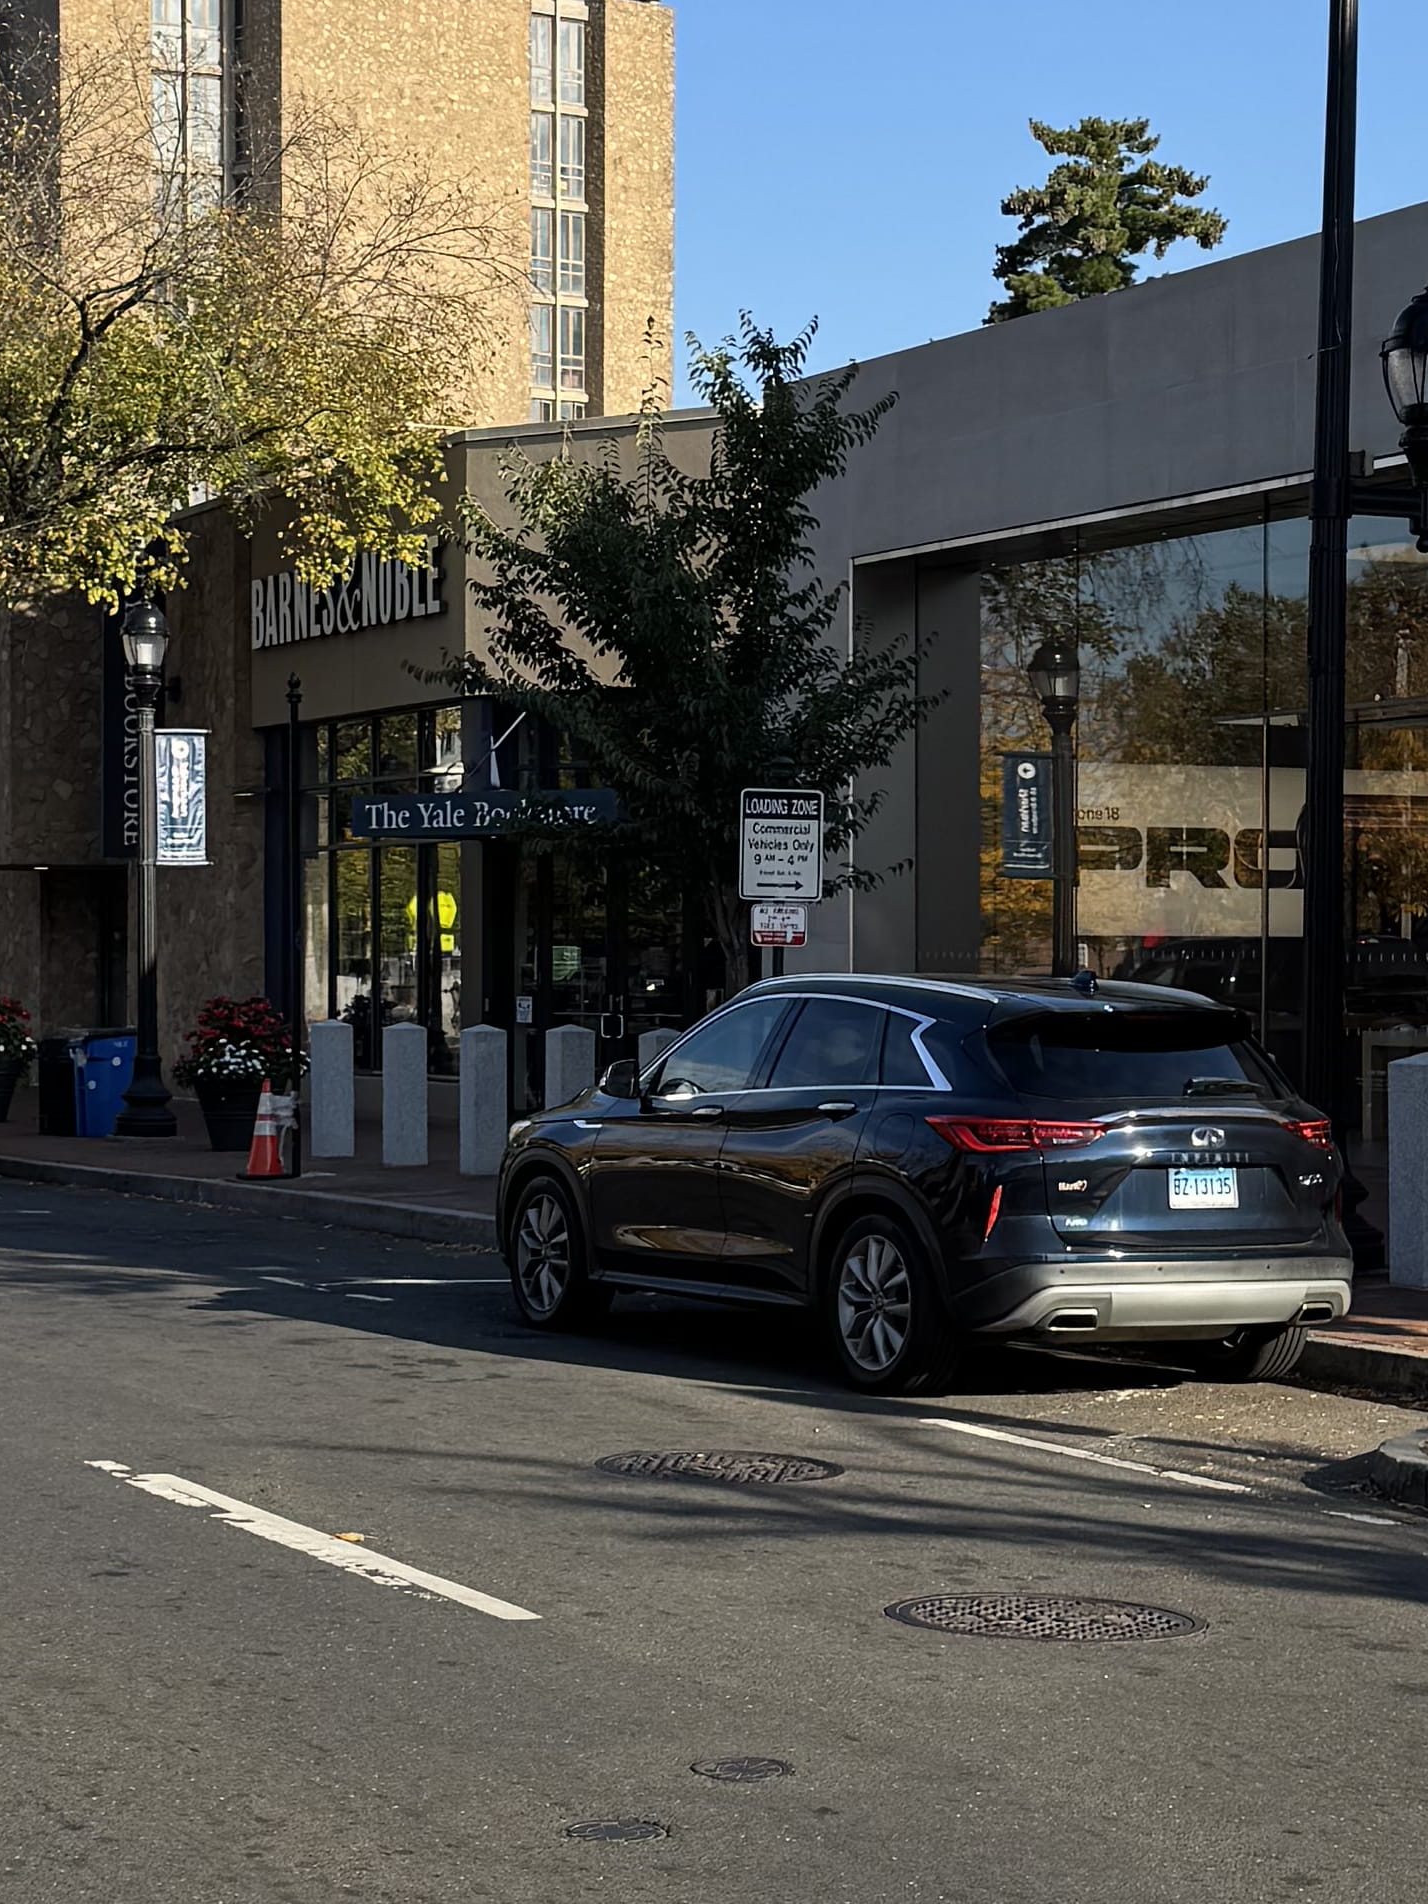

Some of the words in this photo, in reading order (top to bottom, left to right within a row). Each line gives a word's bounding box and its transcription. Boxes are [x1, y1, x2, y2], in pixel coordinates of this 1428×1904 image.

[745, 798, 788, 815] LOADING
[791, 799, 819, 815] ZONE
[365, 802, 410, 829] The
[417, 801, 465, 829] Yale
[752, 822, 811, 835] Commercial
[748, 838, 788, 850] Vehicles
[793, 839, 815, 853] Only
[754, 853, 762, 865] 9
[764, 854, 775, 862] AM
[787, 855, 794, 865] 4
